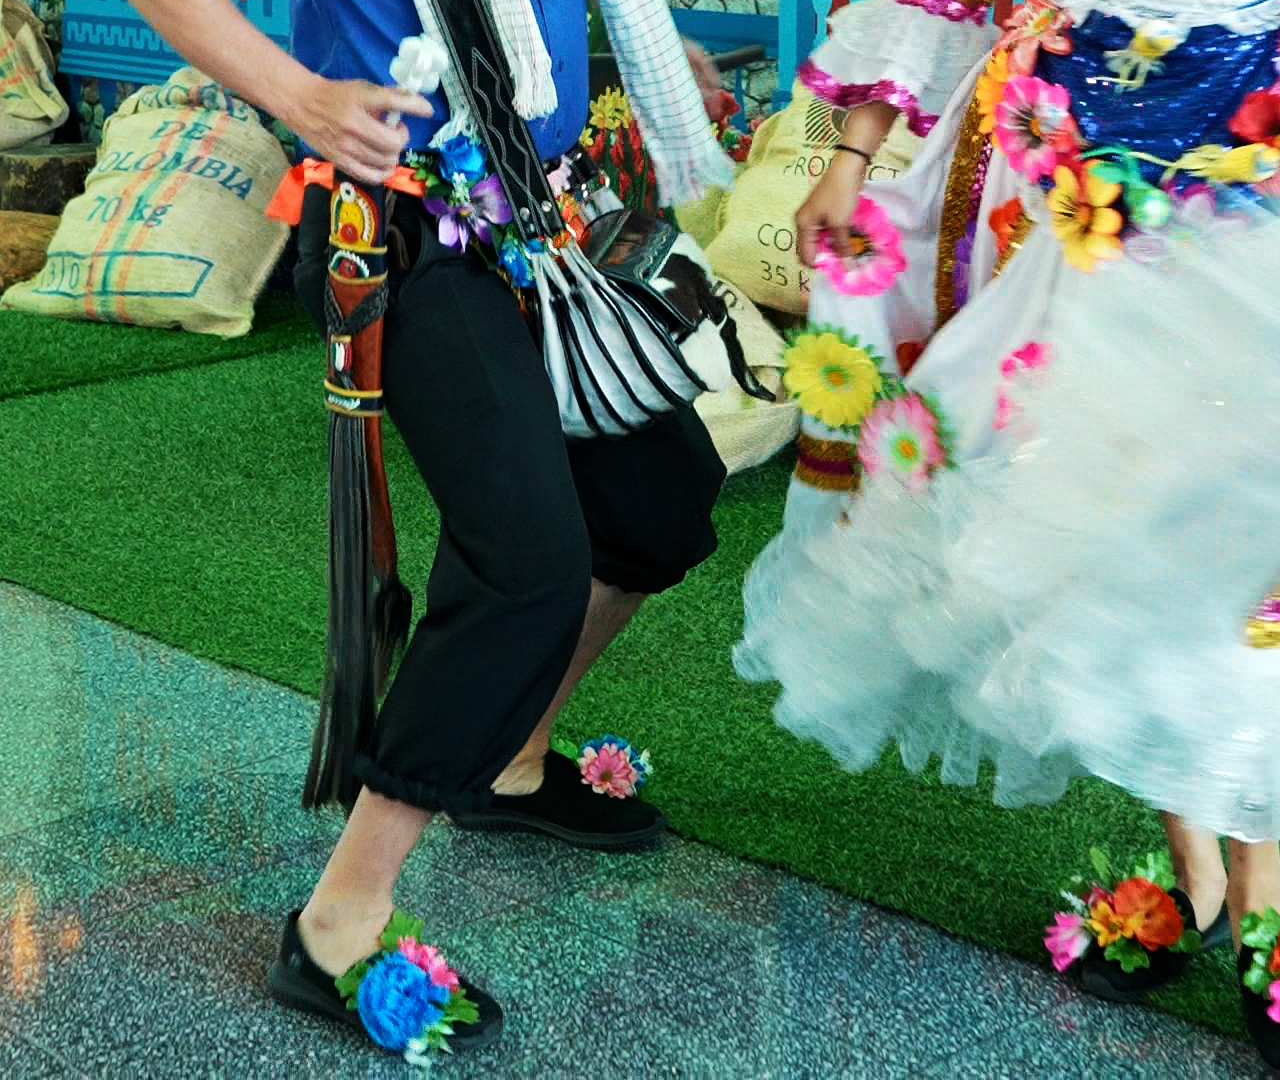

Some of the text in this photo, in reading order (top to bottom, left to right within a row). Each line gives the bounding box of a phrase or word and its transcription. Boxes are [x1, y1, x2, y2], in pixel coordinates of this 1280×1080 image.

[149, 120, 213, 140] DE
[98, 151, 254, 200] OLOMBIA
[87, 194, 174, 227] 70 kg
[760, 259, 788, 287] 35
